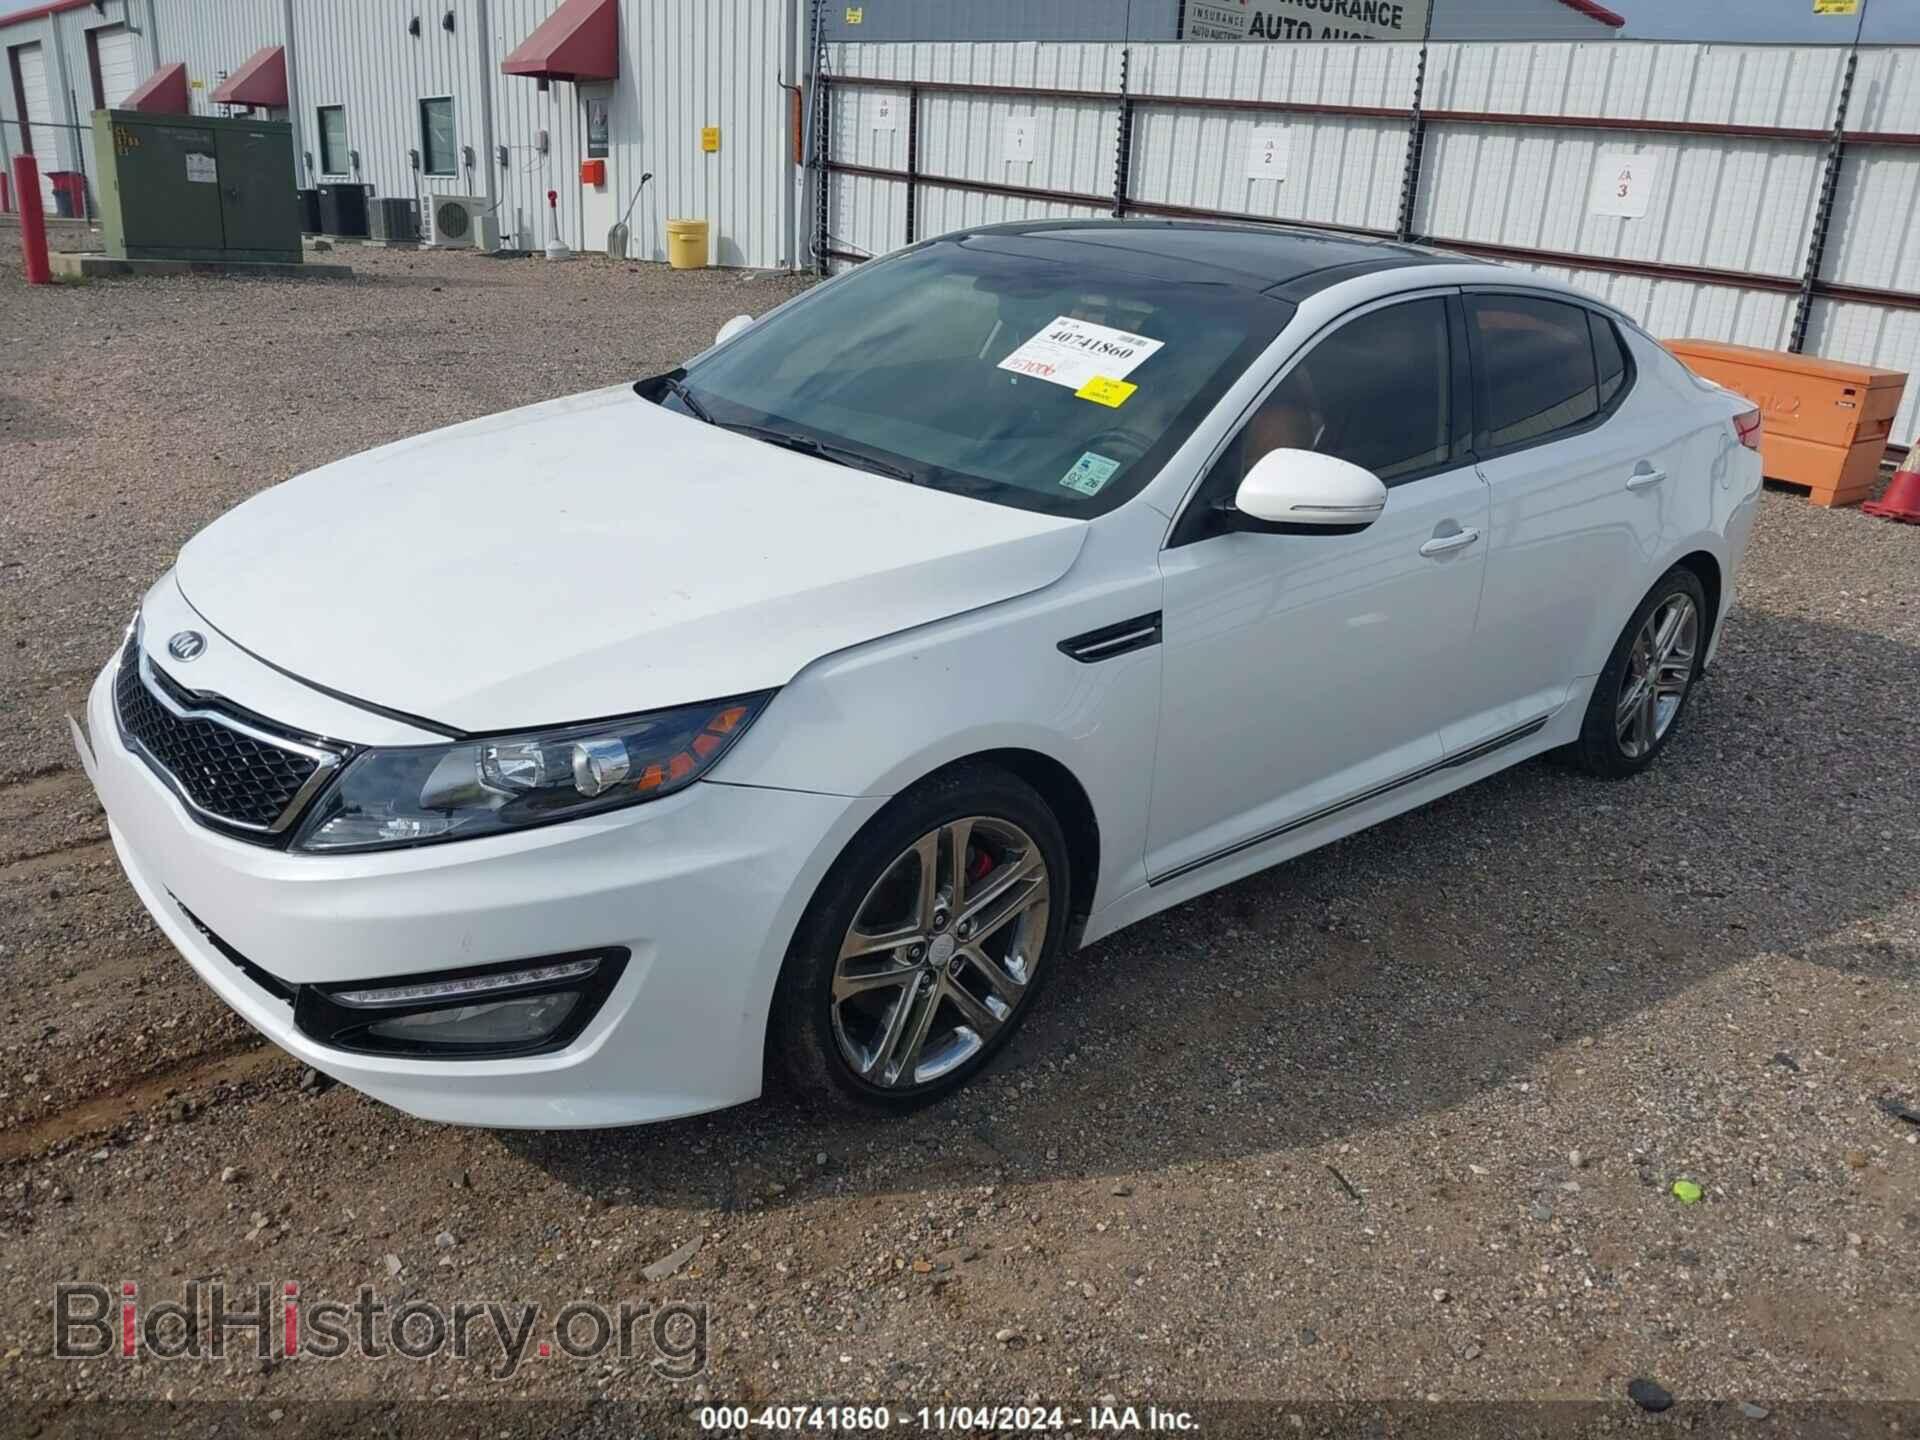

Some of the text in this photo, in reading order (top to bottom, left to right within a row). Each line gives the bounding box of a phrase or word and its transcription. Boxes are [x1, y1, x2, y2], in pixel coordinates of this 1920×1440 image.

[1248, 11, 1312, 39] AUTO
[1280, 0, 1403, 29] URANCE
[1265, 152, 1272, 163] 2
[1617, 184, 1628, 197] 3
[1050, 331, 1134, 359] 40741860
